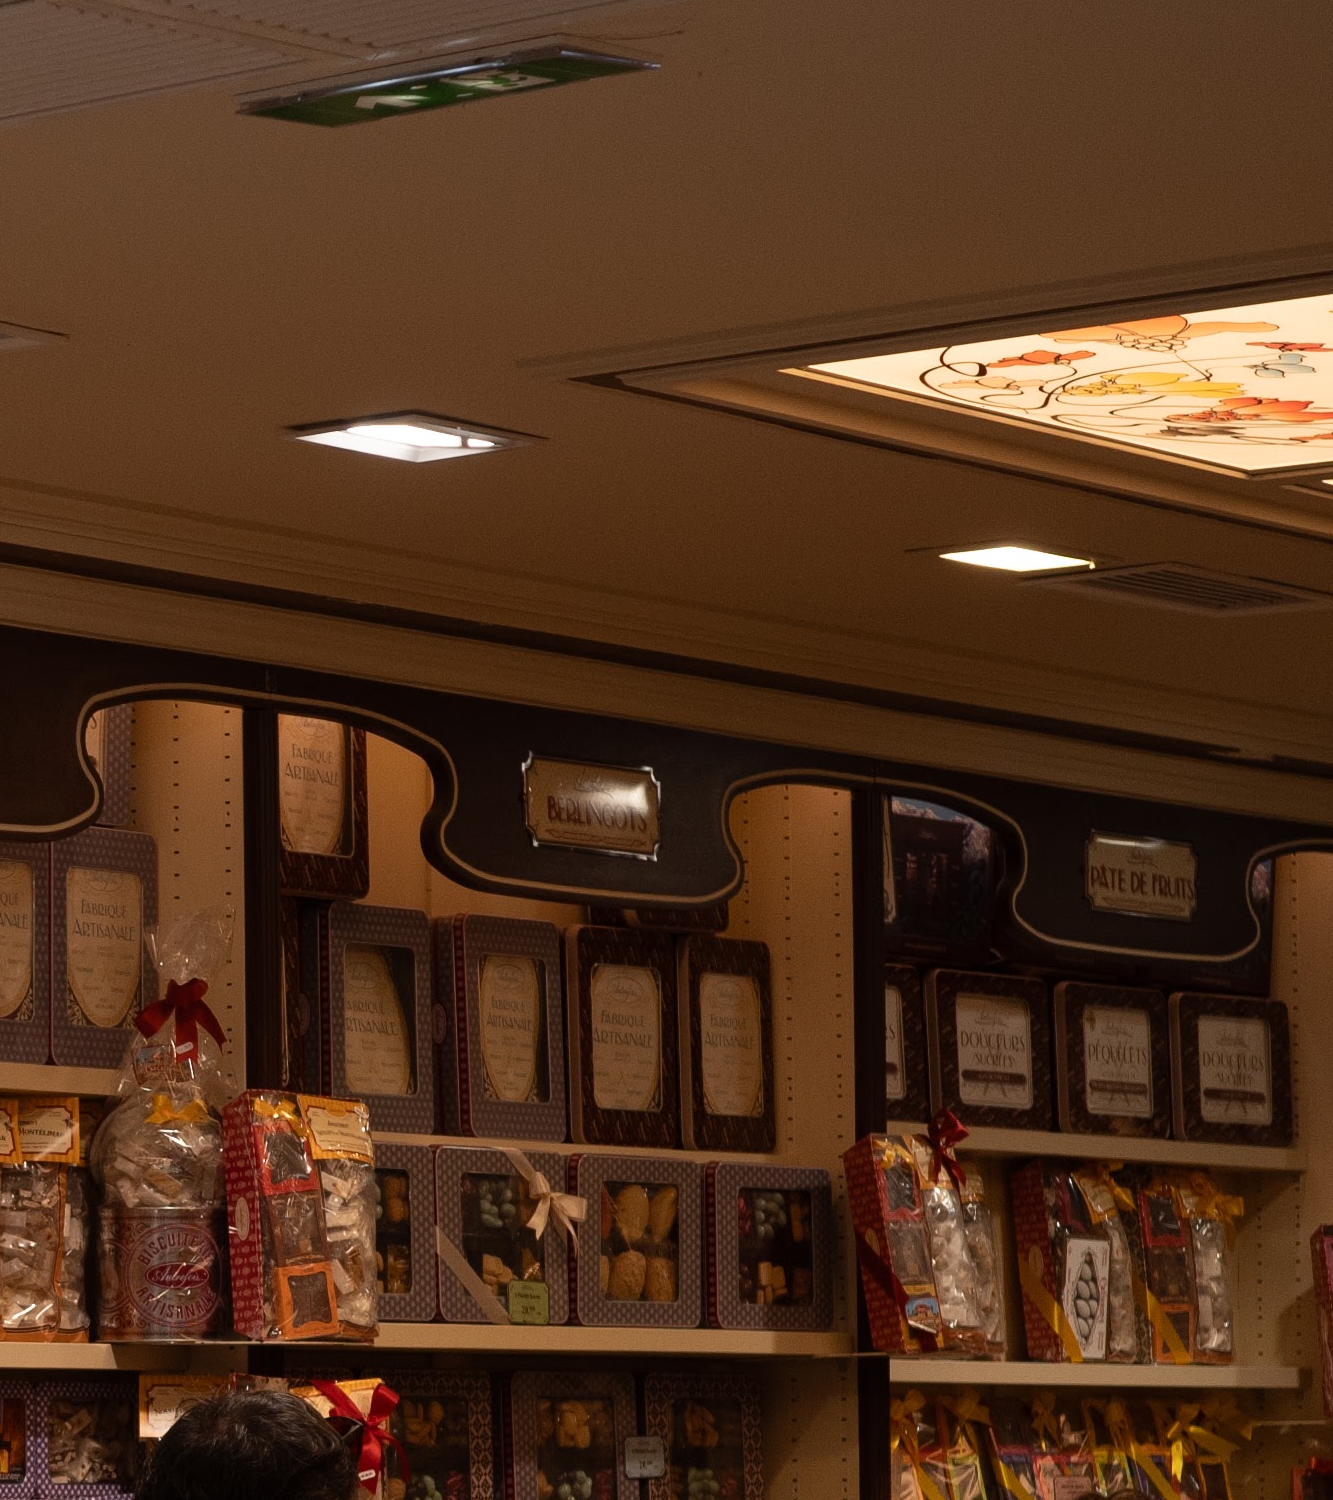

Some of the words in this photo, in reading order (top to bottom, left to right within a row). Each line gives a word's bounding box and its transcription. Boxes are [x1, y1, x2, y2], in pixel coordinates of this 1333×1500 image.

[291, 743, 332, 765] FABRIQUE
[285, 762, 340, 787] ARTISANALE
[1131, 873, 1148, 894] DE
[1152, 877, 1194, 900] FRUITS
[81, 899, 128, 920] FABRIQUE
[73, 918, 136, 942] ARTISANALE
[491, 996, 526, 1016] FABRIQUE
[487, 1013, 534, 1033] ARTISANALE
[599, 1009, 646, 1028] FABRIQUE
[592, 1025, 653, 1049] ARTISANALE
